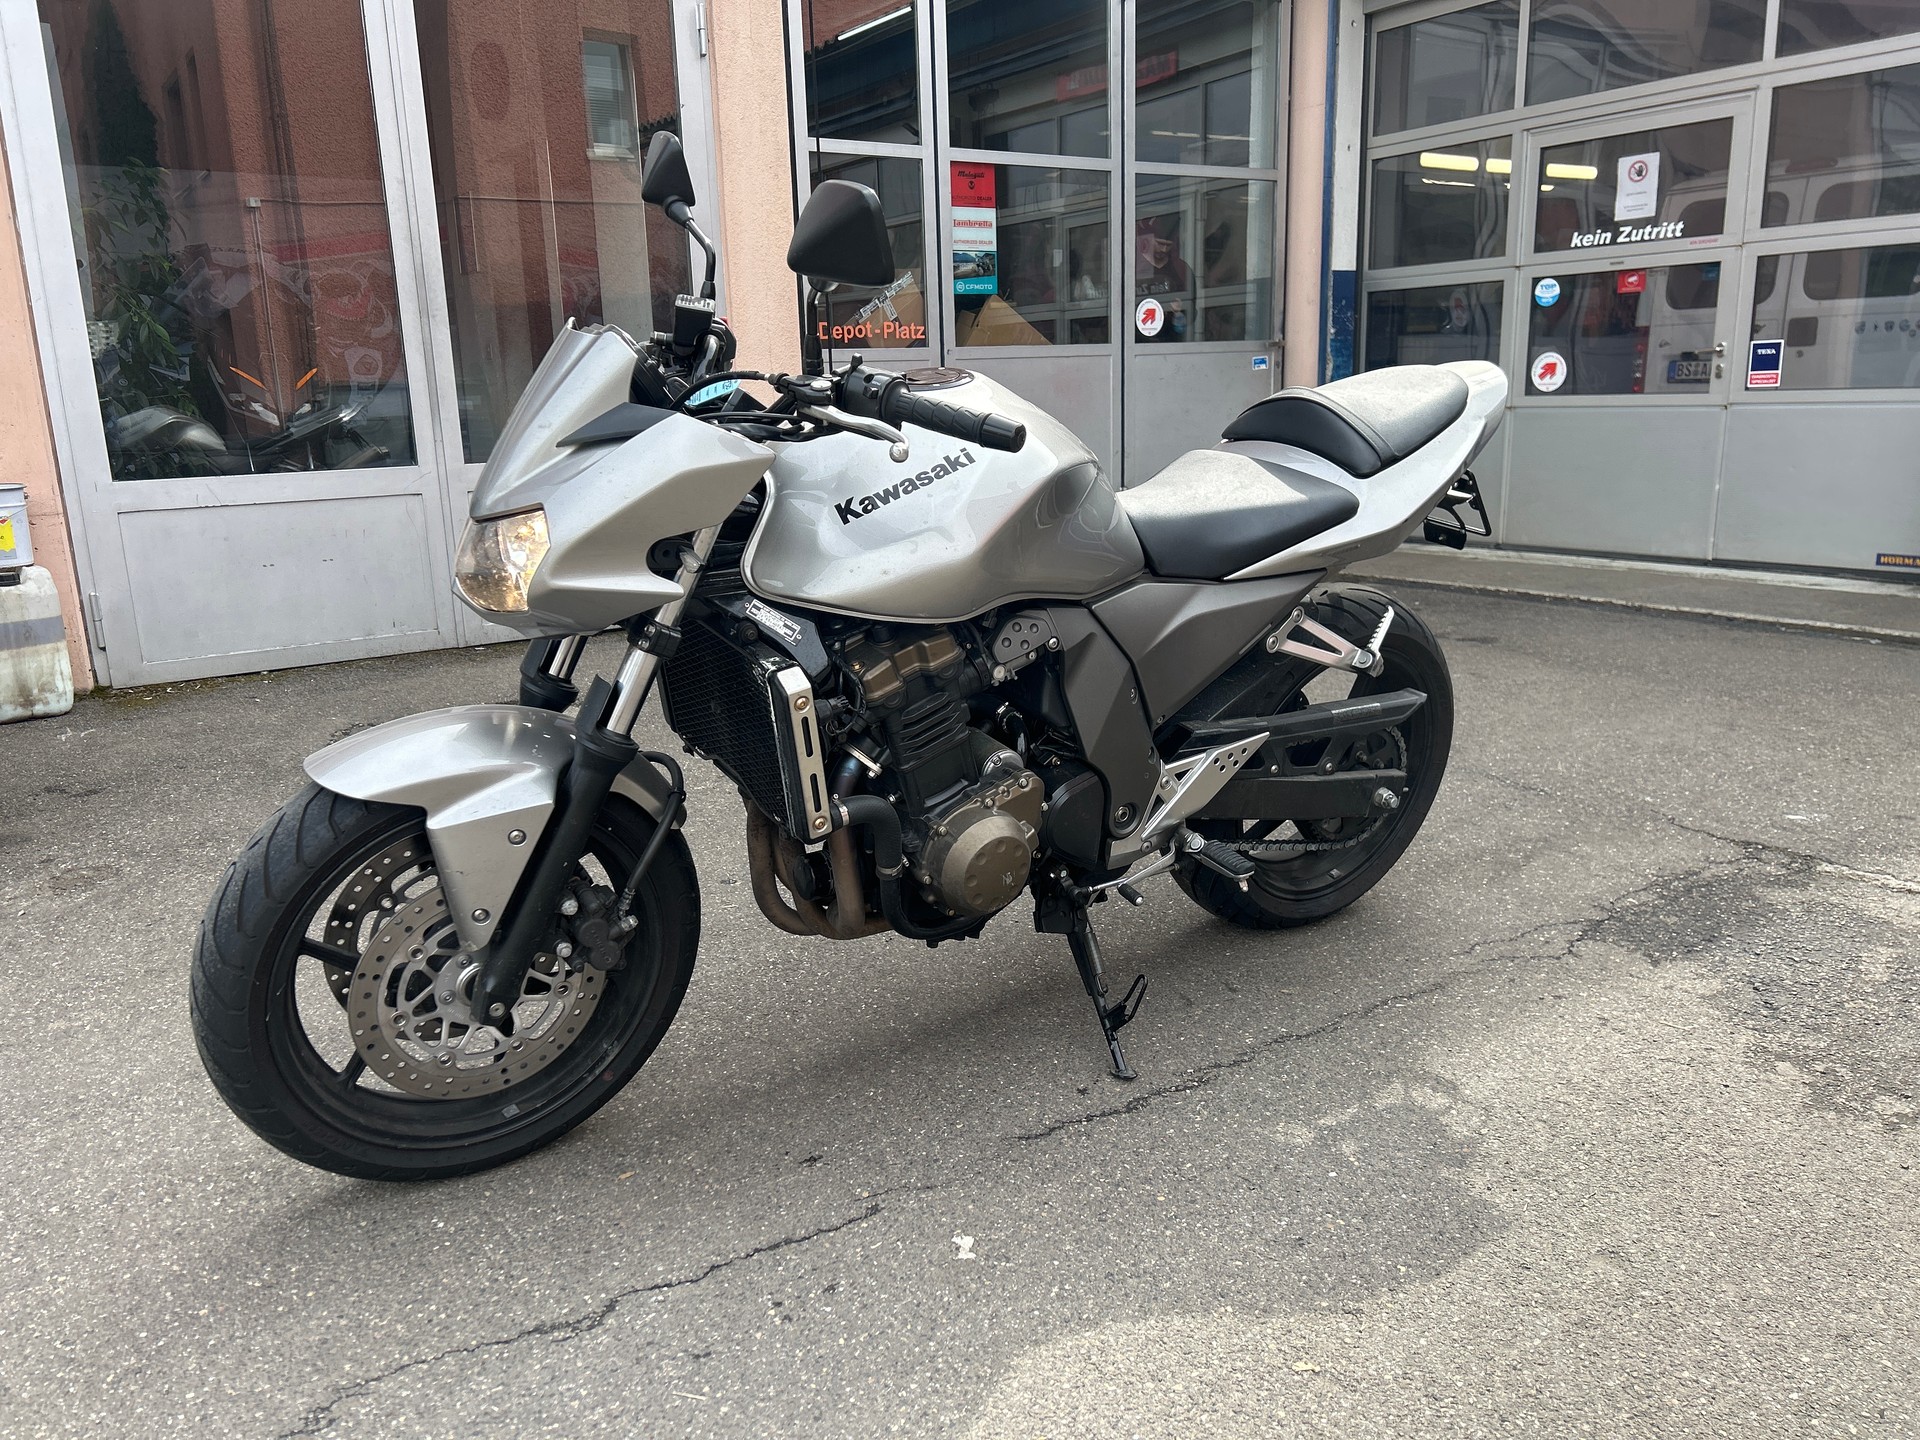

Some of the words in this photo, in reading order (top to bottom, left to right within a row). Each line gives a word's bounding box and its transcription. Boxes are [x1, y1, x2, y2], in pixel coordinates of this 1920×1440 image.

[1570, 229, 1612, 248] kein
[1616, 221, 1685, 243] Zutritt
[833, 447, 977, 526] Kawasaki
